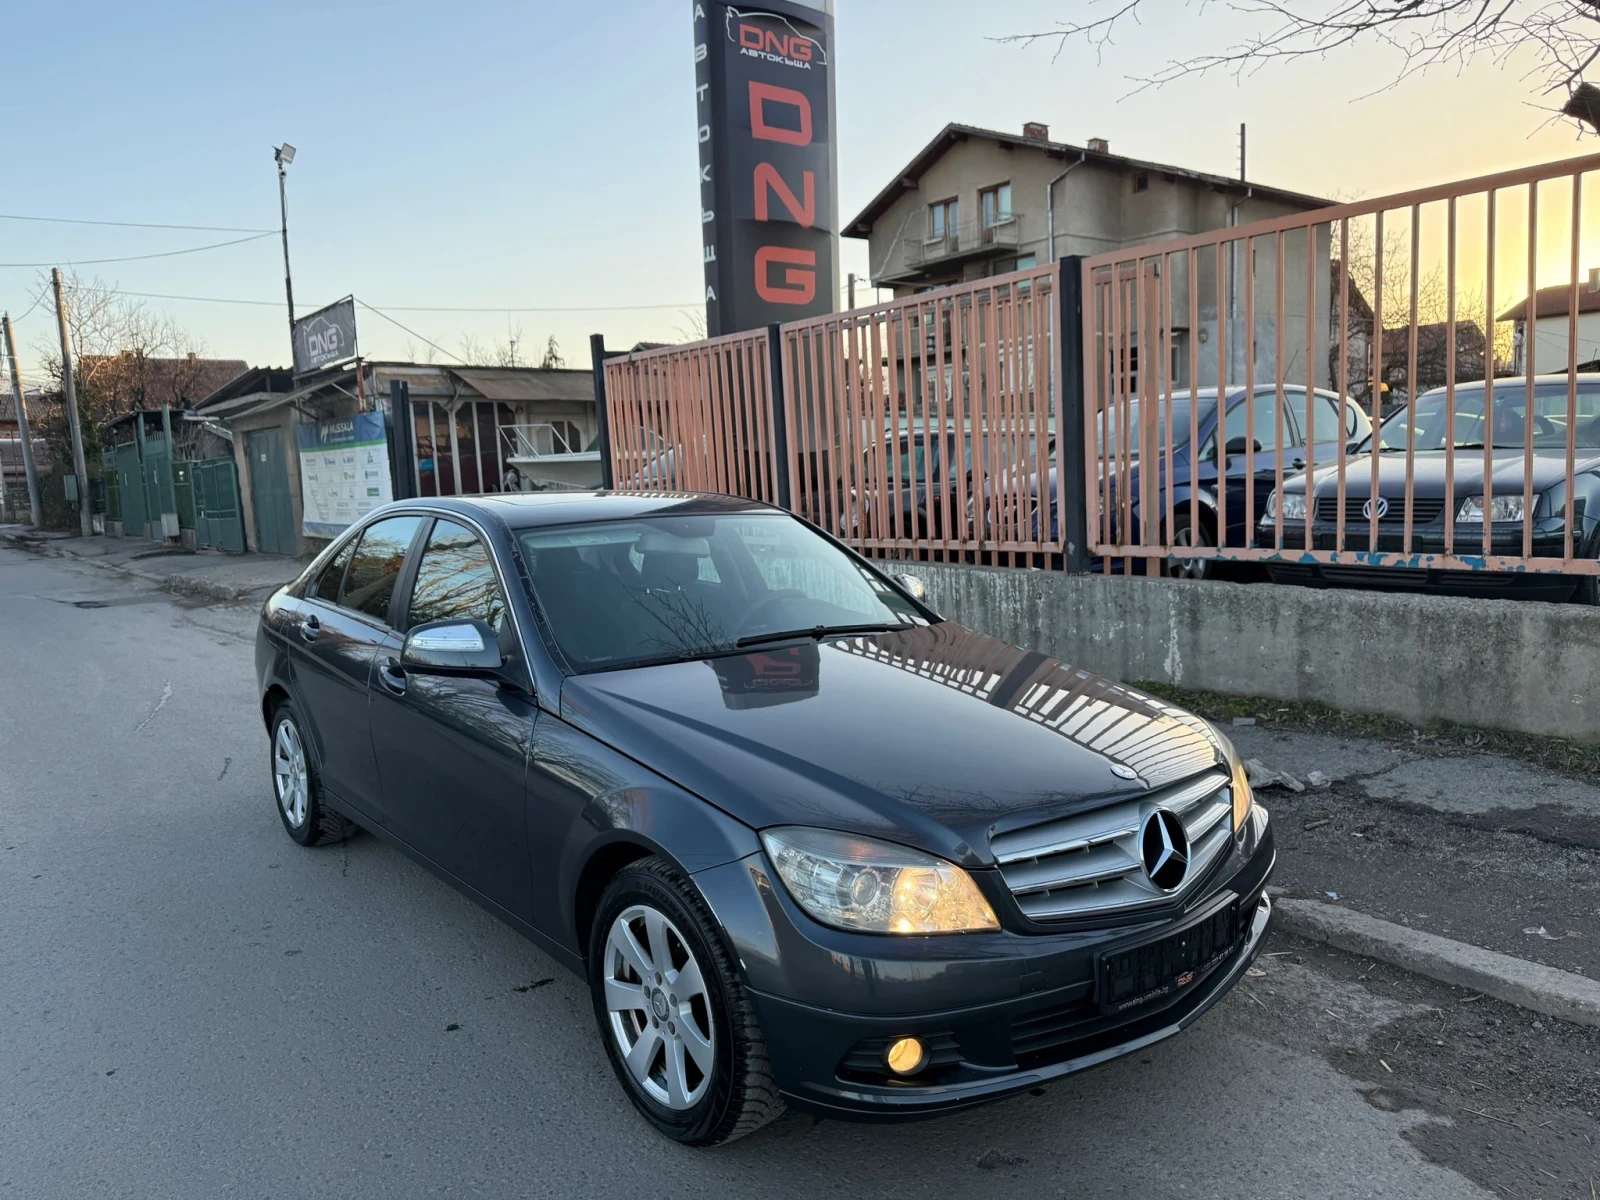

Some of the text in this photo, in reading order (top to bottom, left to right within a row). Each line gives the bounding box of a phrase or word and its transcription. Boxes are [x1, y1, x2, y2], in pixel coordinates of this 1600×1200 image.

[739, 23, 812, 62] DNG
[740, 47, 811, 70] АВТОКЪЩА
[748, 80, 816, 305] DNG
[308, 327, 338, 357] DNG
